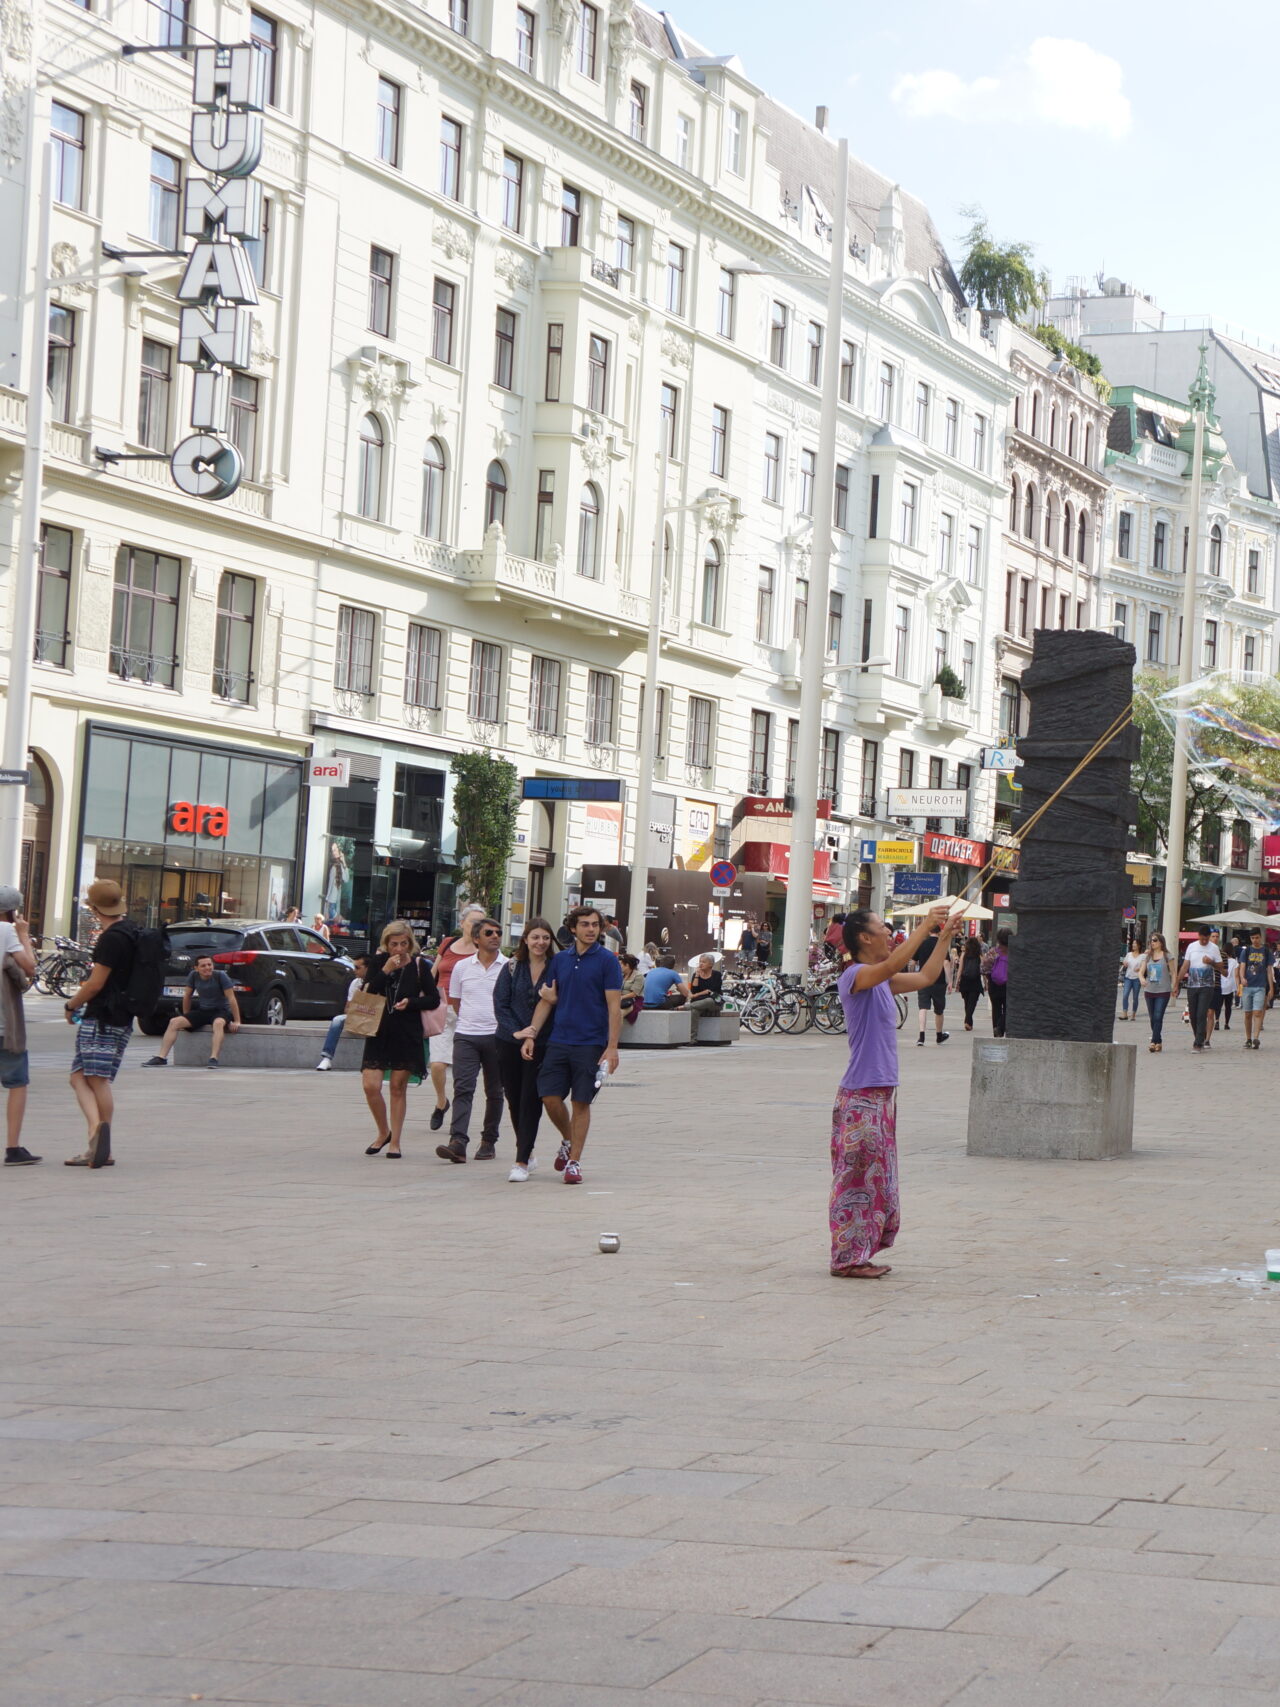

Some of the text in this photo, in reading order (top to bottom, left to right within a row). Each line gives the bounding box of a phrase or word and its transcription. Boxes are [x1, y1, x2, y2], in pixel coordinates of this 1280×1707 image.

[170, 44, 264, 501] HUMANIC
[313, 765, 338, 777] ara
[911, 795, 962, 805] NEUROTH
[172, 801, 230, 837] ara
[863, 844, 873, 859] L
[931, 837, 973, 860] OPTIKER
